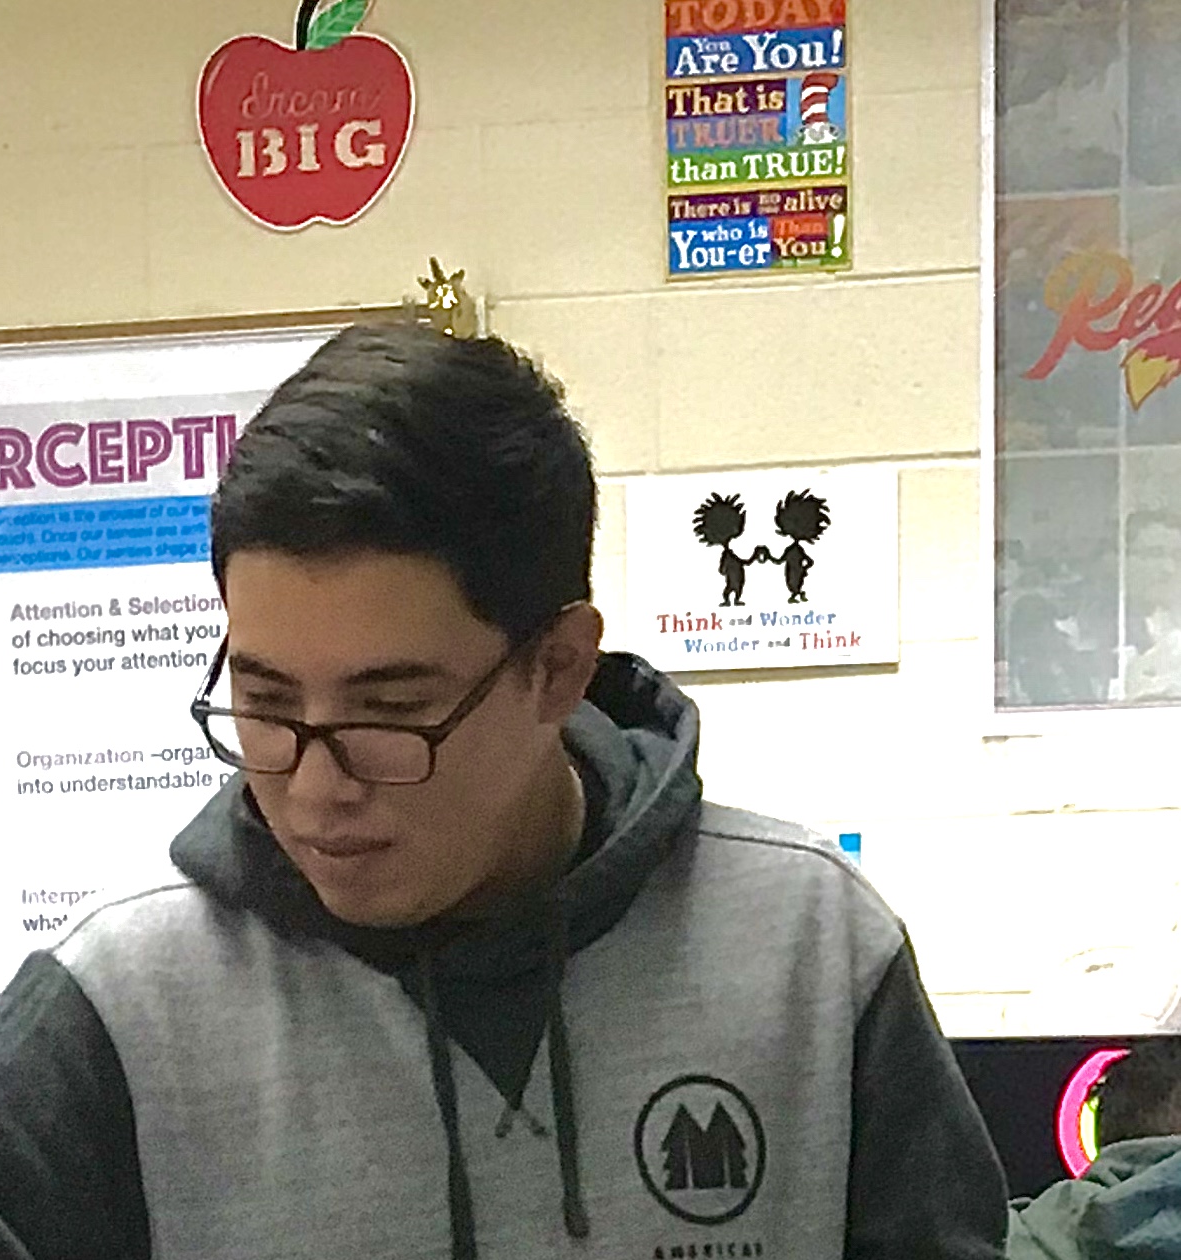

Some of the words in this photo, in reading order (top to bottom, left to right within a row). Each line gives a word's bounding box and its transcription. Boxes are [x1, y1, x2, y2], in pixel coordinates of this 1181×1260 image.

[673, 46, 740, 75] Are
[742, 29, 844, 71] You!
[691, 37, 731, 53] You
[669, 86, 750, 116] That
[756, 83, 785, 111] is
[671, 117, 784, 149] TRUER
[236, 119, 386, 178] BIG
[671, 158, 737, 183] than
[743, 146, 845, 179] TRUE!
[671, 199, 731, 219] There
[733, 198, 752, 215] is
[784, 189, 843, 212] alive
[701, 225, 742, 241] who
[748, 220, 768, 239] is
[671, 229, 772, 269] You-er
[10, 600, 103, 622] Attention
[109, 598, 122, 617] &
[128, 594, 223, 616] Selection
[657, 612, 723, 633] Think
[759, 610, 837, 626] Wonder
[12, 629, 31, 649] of
[36, 626, 126, 647] choosing
[131, 623, 179, 642] what
[185, 624, 221, 644] you
[684, 636, 760, 653] Wonder
[799, 629, 862, 650] Think
[13, 657, 67, 675] focus
[72, 656, 115, 677] your
[121, 649, 207, 670] attention
[16, 748, 144, 771] Organization
[18, 779, 54, 795] into
[60, 770, 213, 792] understandable
